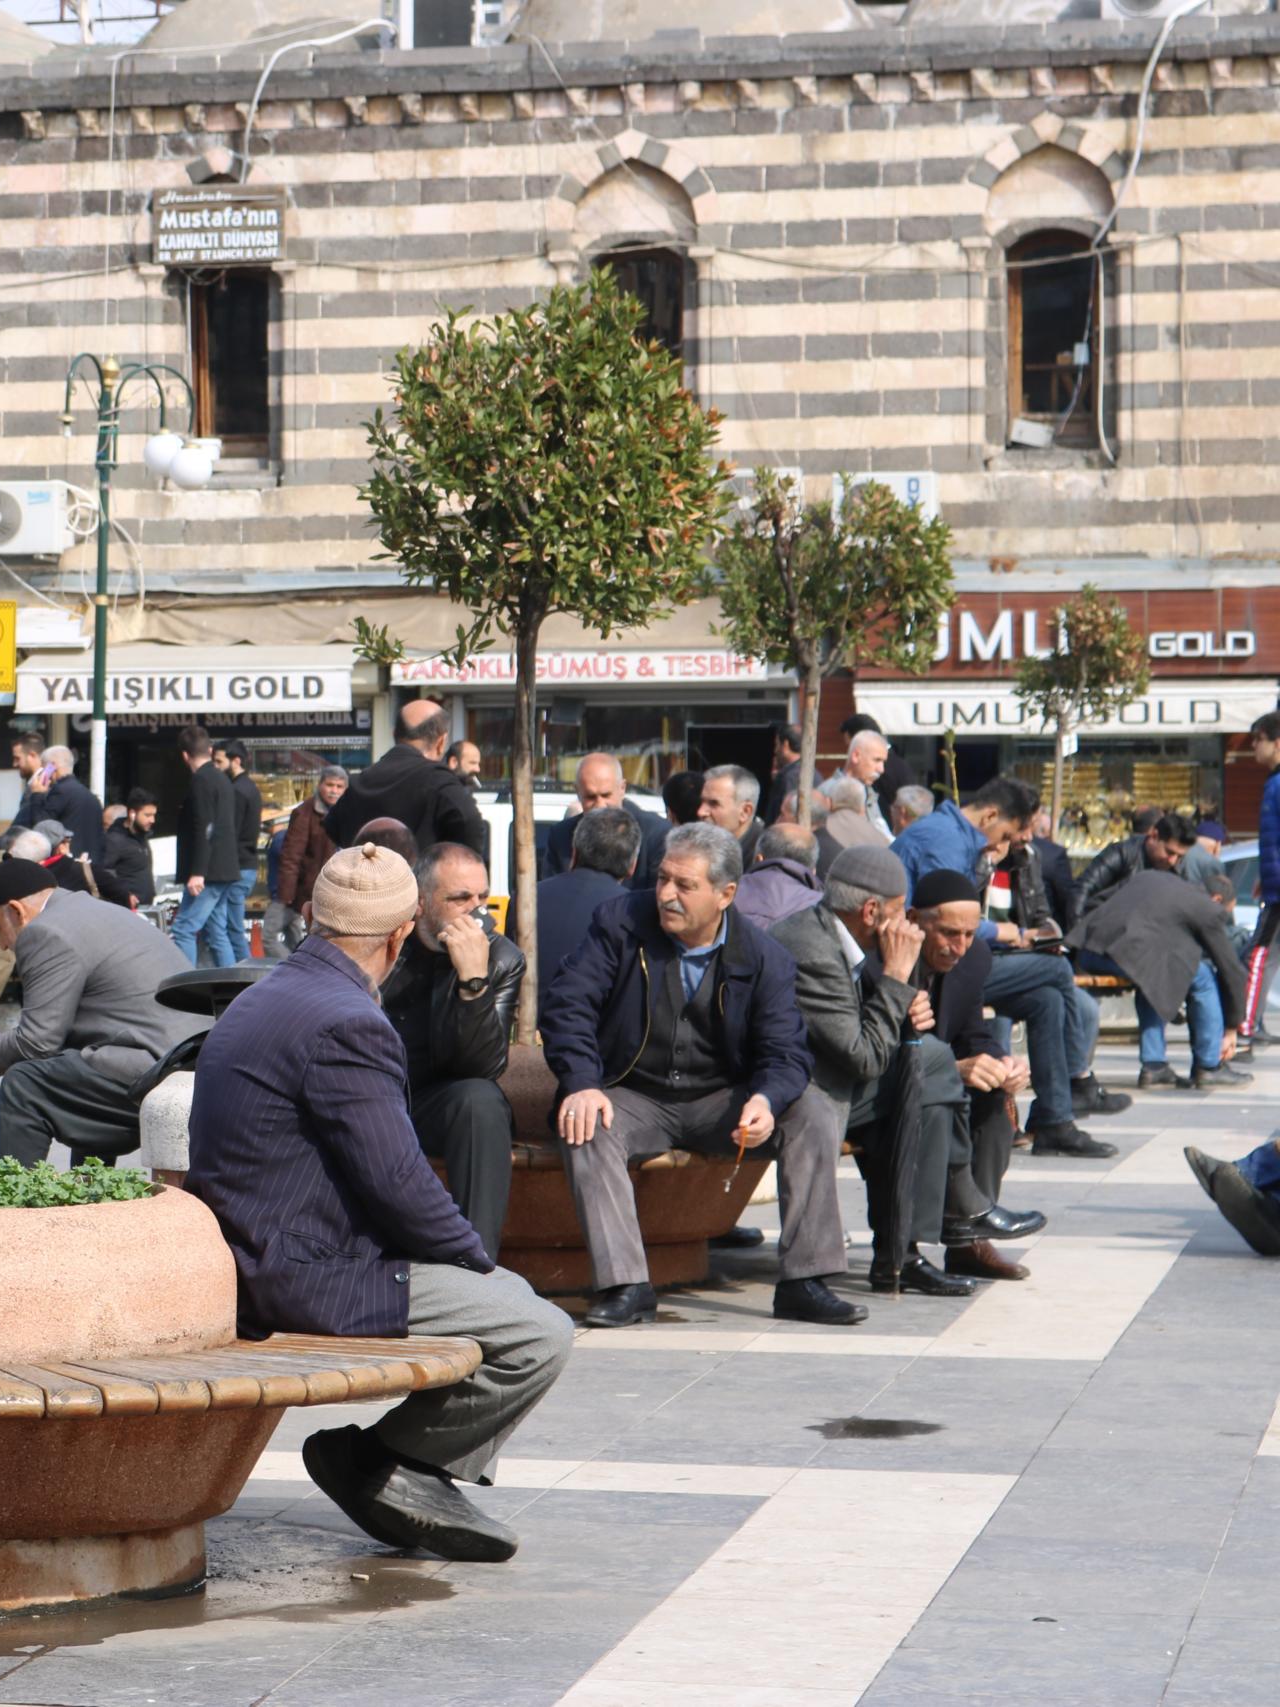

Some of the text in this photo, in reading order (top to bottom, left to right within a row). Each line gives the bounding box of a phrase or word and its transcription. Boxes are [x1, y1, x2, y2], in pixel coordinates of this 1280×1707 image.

[160, 207, 278, 229] Mustafa'nın
[159, 229, 278, 249] KAHVALTI DÜNYASI
[1148, 630, 1257, 658] GOLD
[636, 655, 656, 677] &
[228, 676, 325, 701] GOLD
